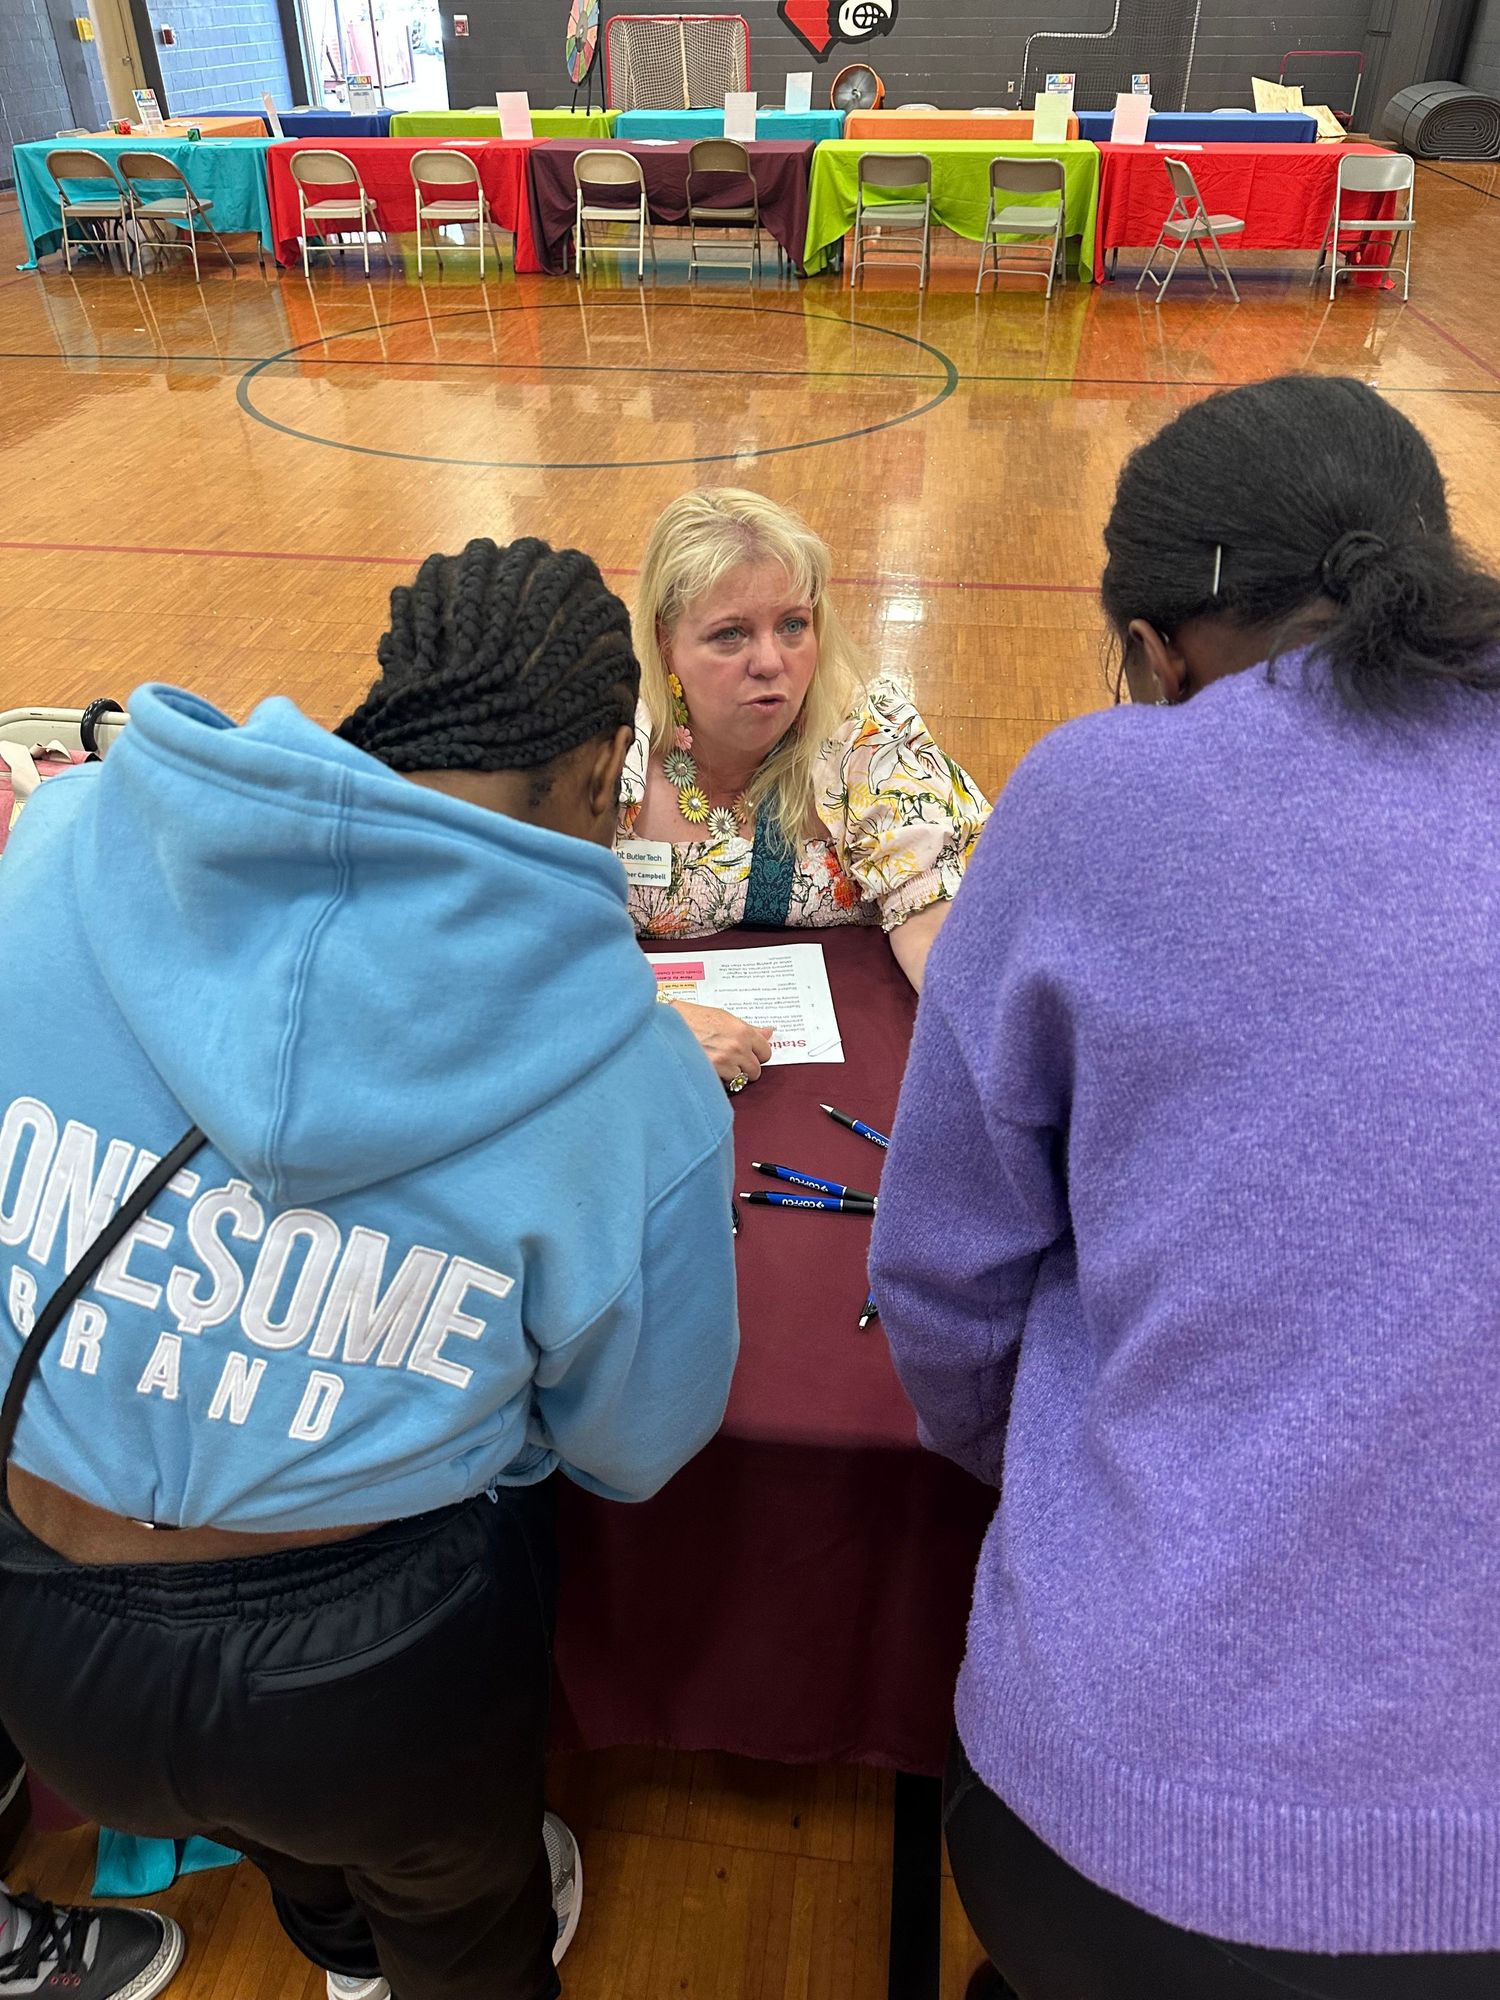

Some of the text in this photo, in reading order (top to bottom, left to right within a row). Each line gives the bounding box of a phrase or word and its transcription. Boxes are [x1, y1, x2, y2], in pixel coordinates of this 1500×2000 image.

[626, 852, 646, 861] Butler
[646, 853, 662, 862] Tech
[637, 872, 666, 880] Campbell
[8, 1265, 345, 1441] BRAND
